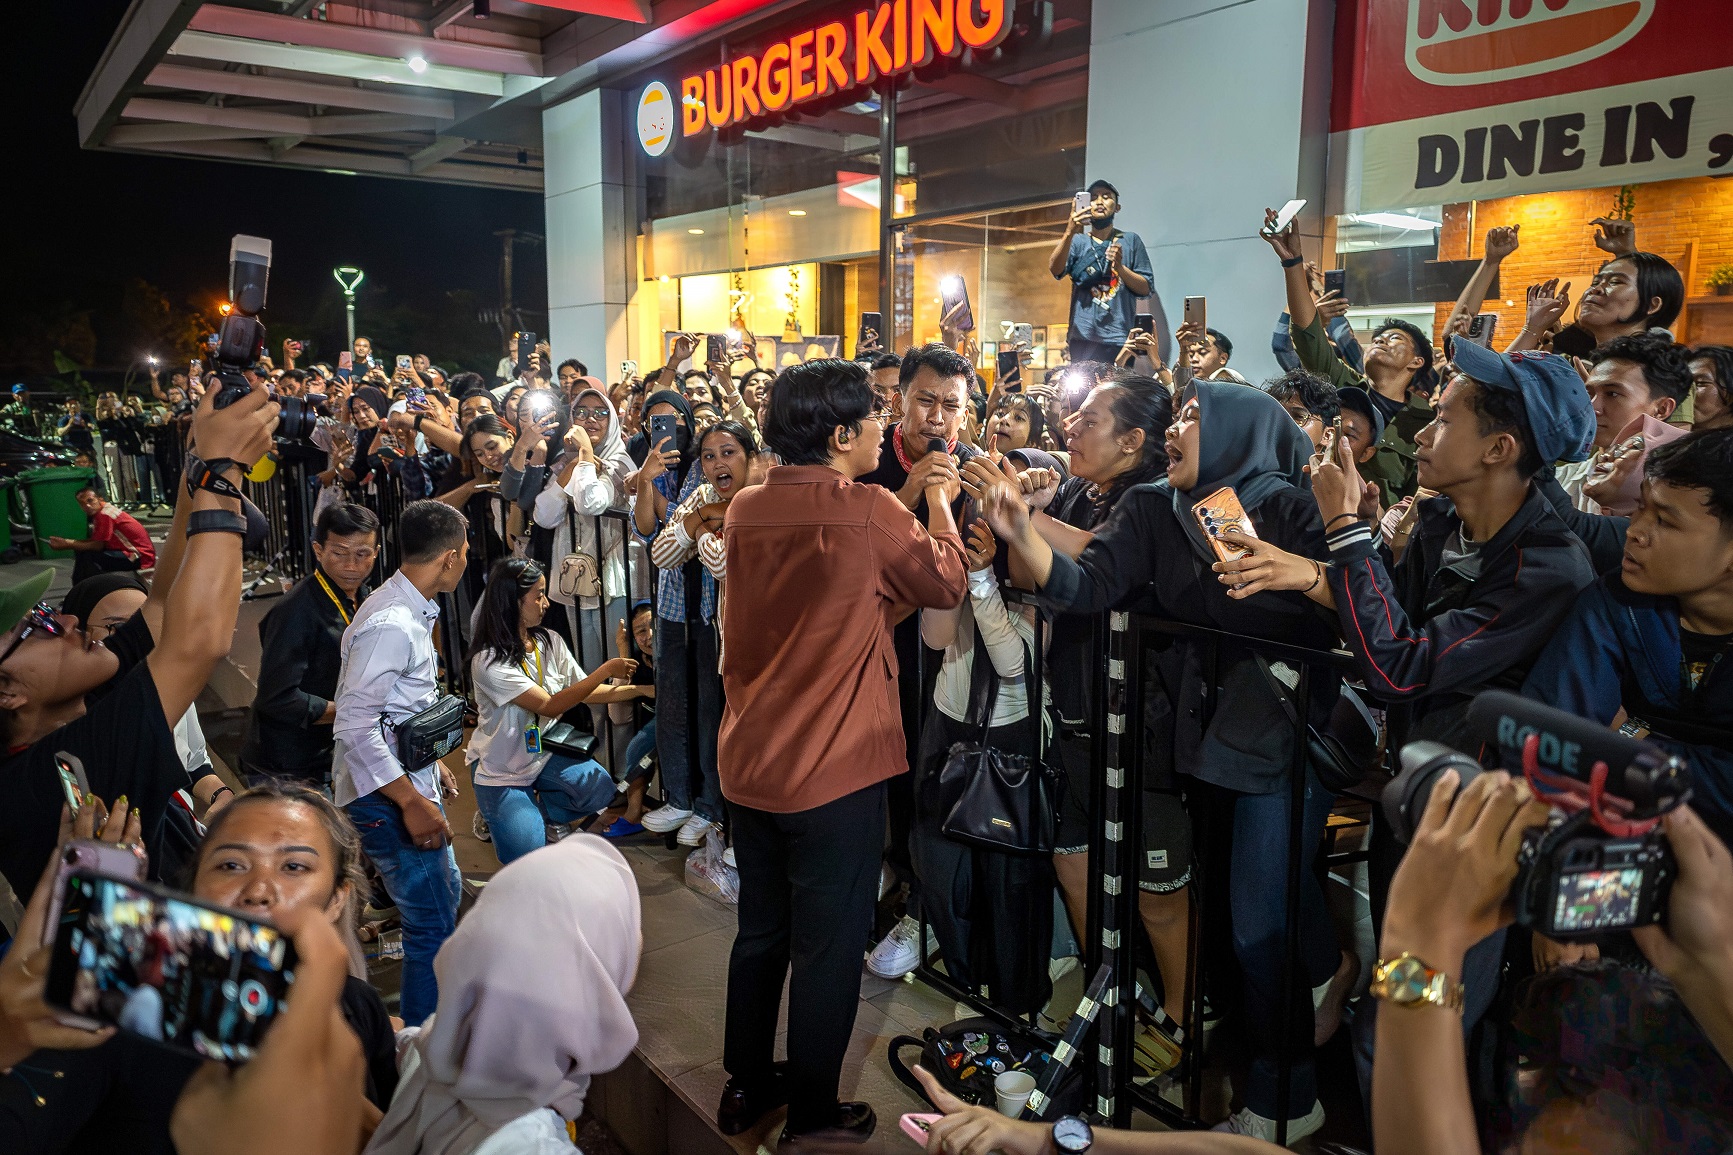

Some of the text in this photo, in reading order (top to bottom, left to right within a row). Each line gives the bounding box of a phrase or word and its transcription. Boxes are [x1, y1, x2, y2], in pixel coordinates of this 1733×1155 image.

[681, 0, 1004, 137] BURGER KING
[1415, 112, 1586, 189] DINE
